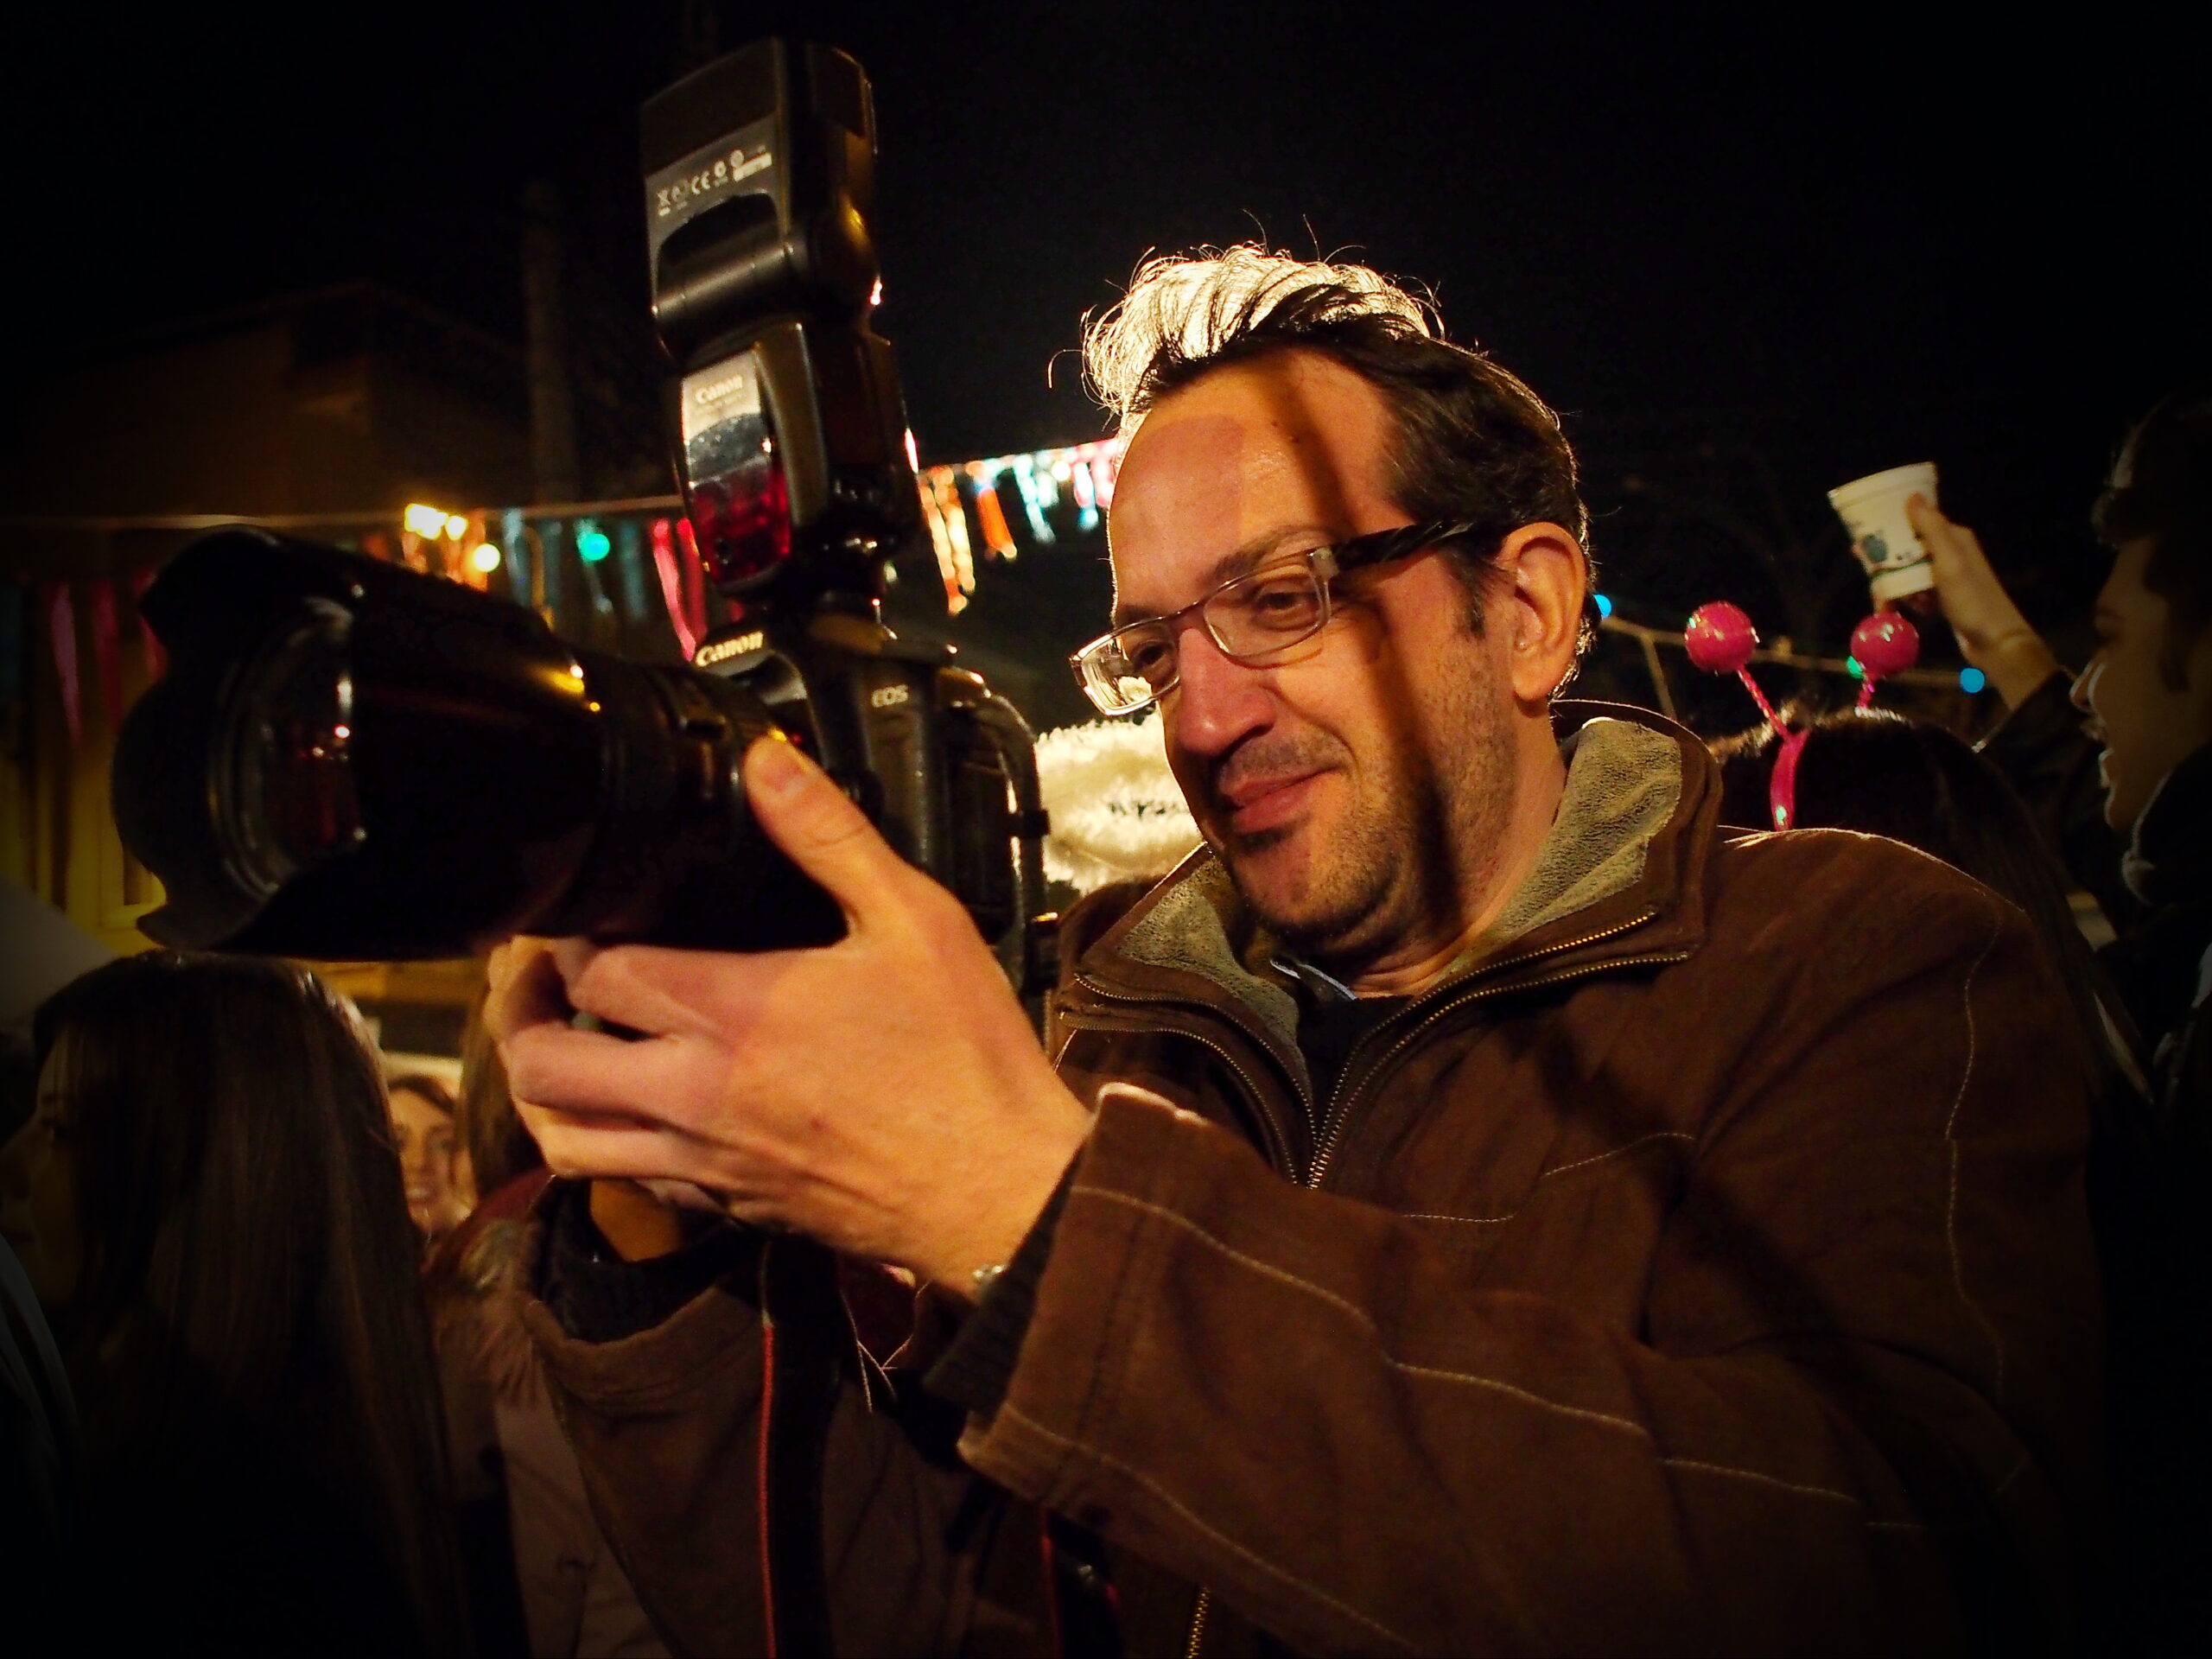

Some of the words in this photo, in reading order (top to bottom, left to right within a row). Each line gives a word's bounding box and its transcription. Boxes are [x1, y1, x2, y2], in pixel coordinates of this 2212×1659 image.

[695, 374, 744, 404] Canon
[696, 631, 764, 667] Canon
[871, 684, 908, 708] EOS
